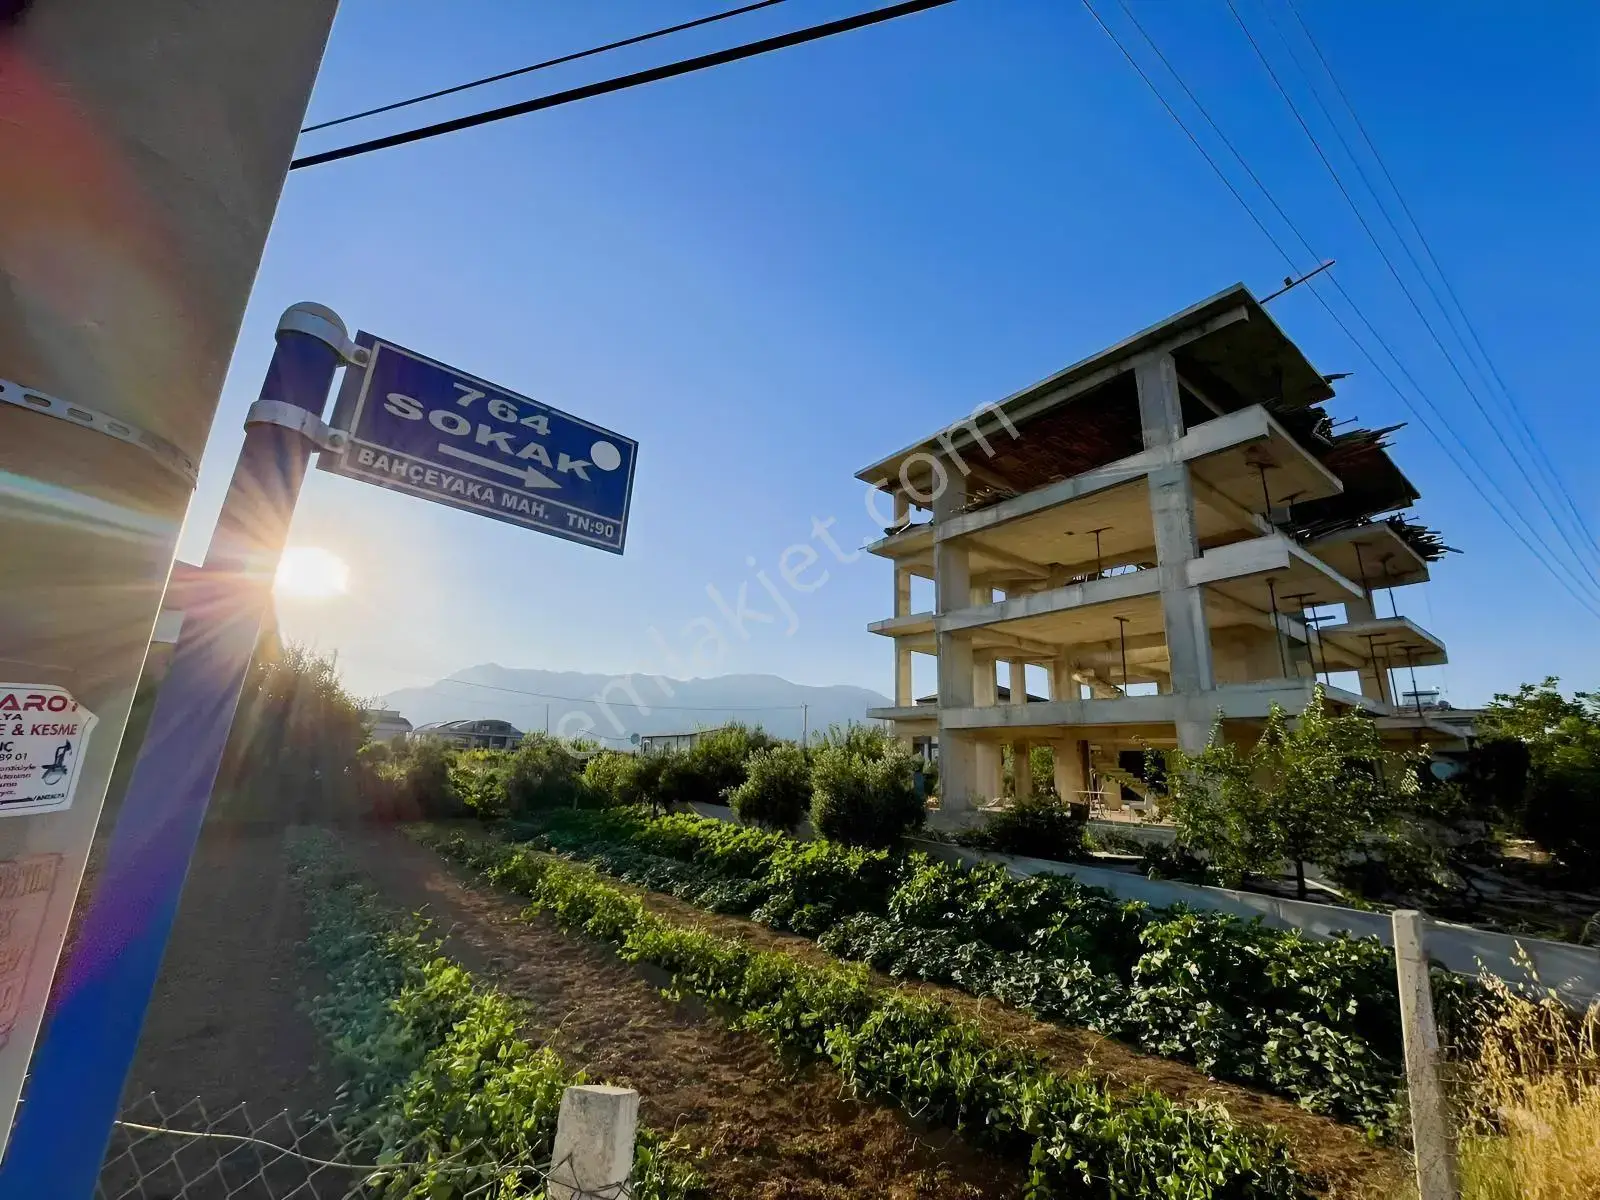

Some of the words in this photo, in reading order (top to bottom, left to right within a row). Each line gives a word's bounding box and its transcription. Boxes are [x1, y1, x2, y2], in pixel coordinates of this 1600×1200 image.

[384, 392, 594, 483] SOKAK
[453, 382, 551, 436] 764
[357, 448, 496, 504] BAHÇEYAKA
[501, 492, 550, 520] MAH.
[566, 512, 615, 538] TN:90
[30, 724, 79, 736] KESME
